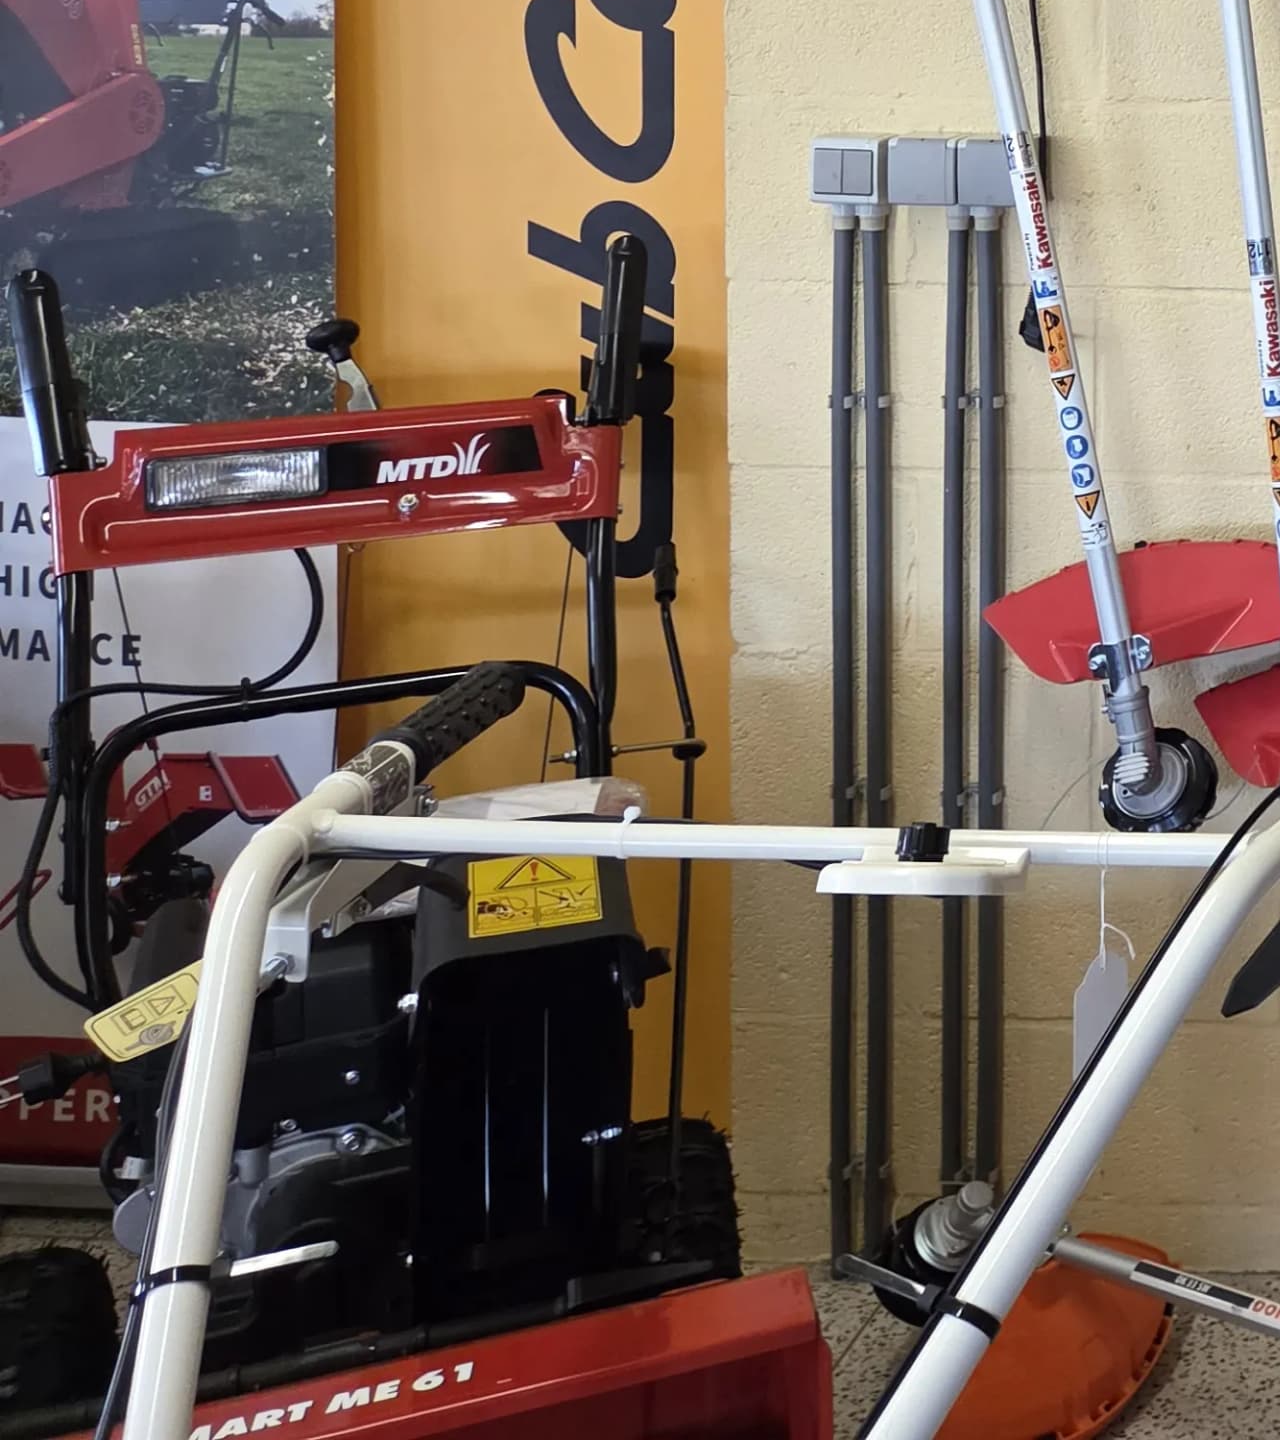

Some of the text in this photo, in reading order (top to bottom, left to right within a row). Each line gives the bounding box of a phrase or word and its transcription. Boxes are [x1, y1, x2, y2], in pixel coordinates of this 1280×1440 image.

[1020, 171, 1054, 270] Kawasaki
[376, 455, 459, 484] MTD
[325, 1379, 401, 1415] ME
[411, 1362, 474, 1392] 61
